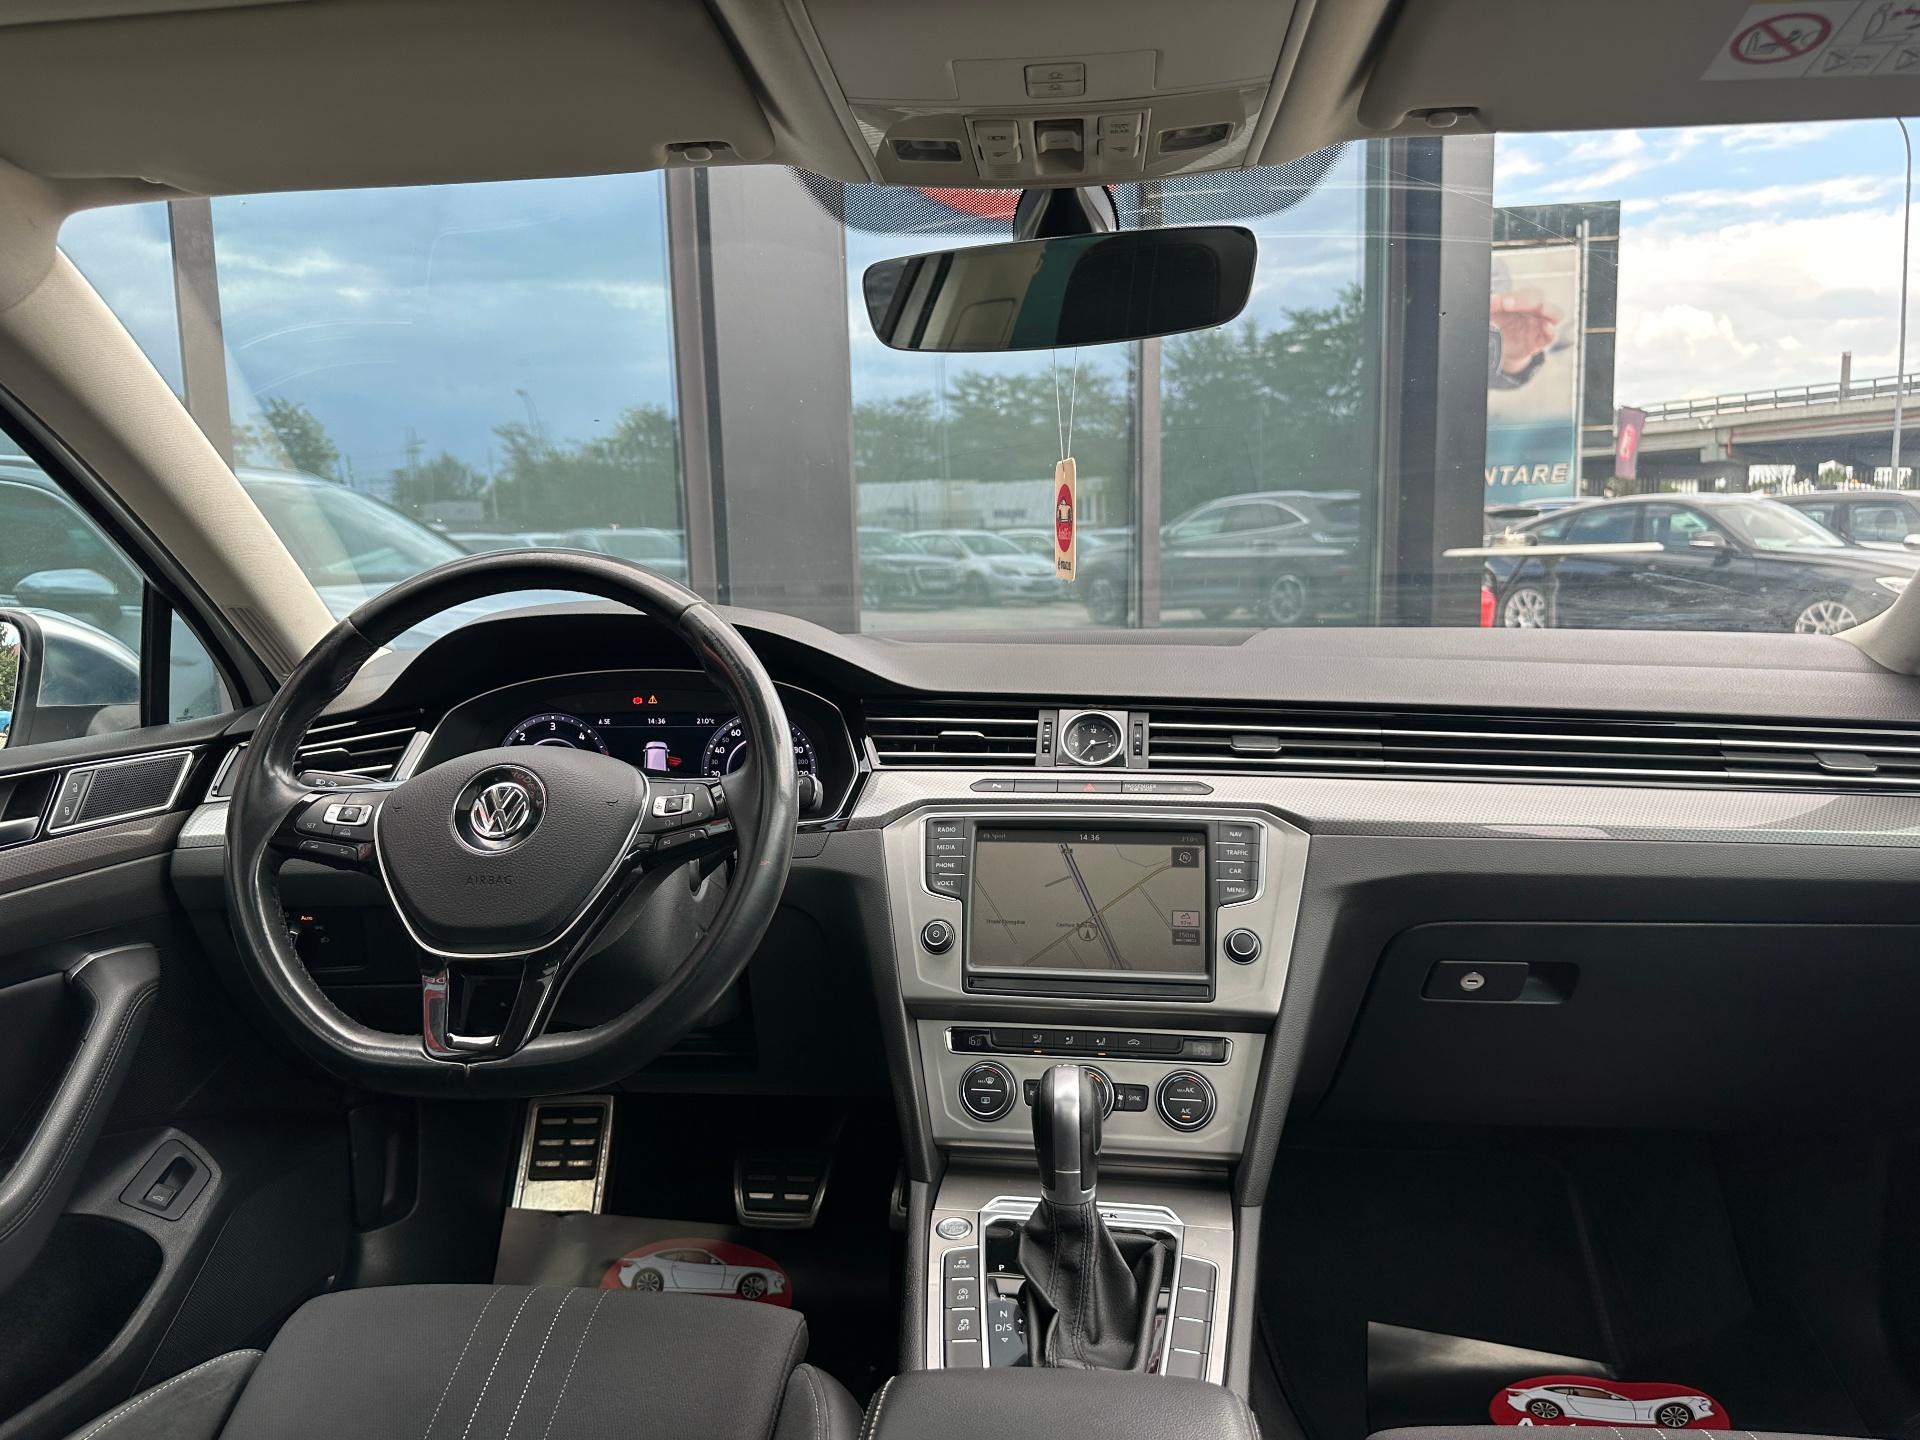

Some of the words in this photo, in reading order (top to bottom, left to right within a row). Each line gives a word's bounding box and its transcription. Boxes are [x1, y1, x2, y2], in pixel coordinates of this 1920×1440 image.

[549, 722, 556, 731] 3
[520, 732, 526, 741] 2
[578, 732, 585, 740] 4
[730, 729, 742, 737] 60
[714, 746, 725, 754] 40
[465, 875, 513, 885] AIRBAG
[1000, 1294, 1007, 1302] R
[999, 1310, 1008, 1318] N
[957, 1324, 970, 1332] OFF
[995, 1323, 1013, 1332] D/S
